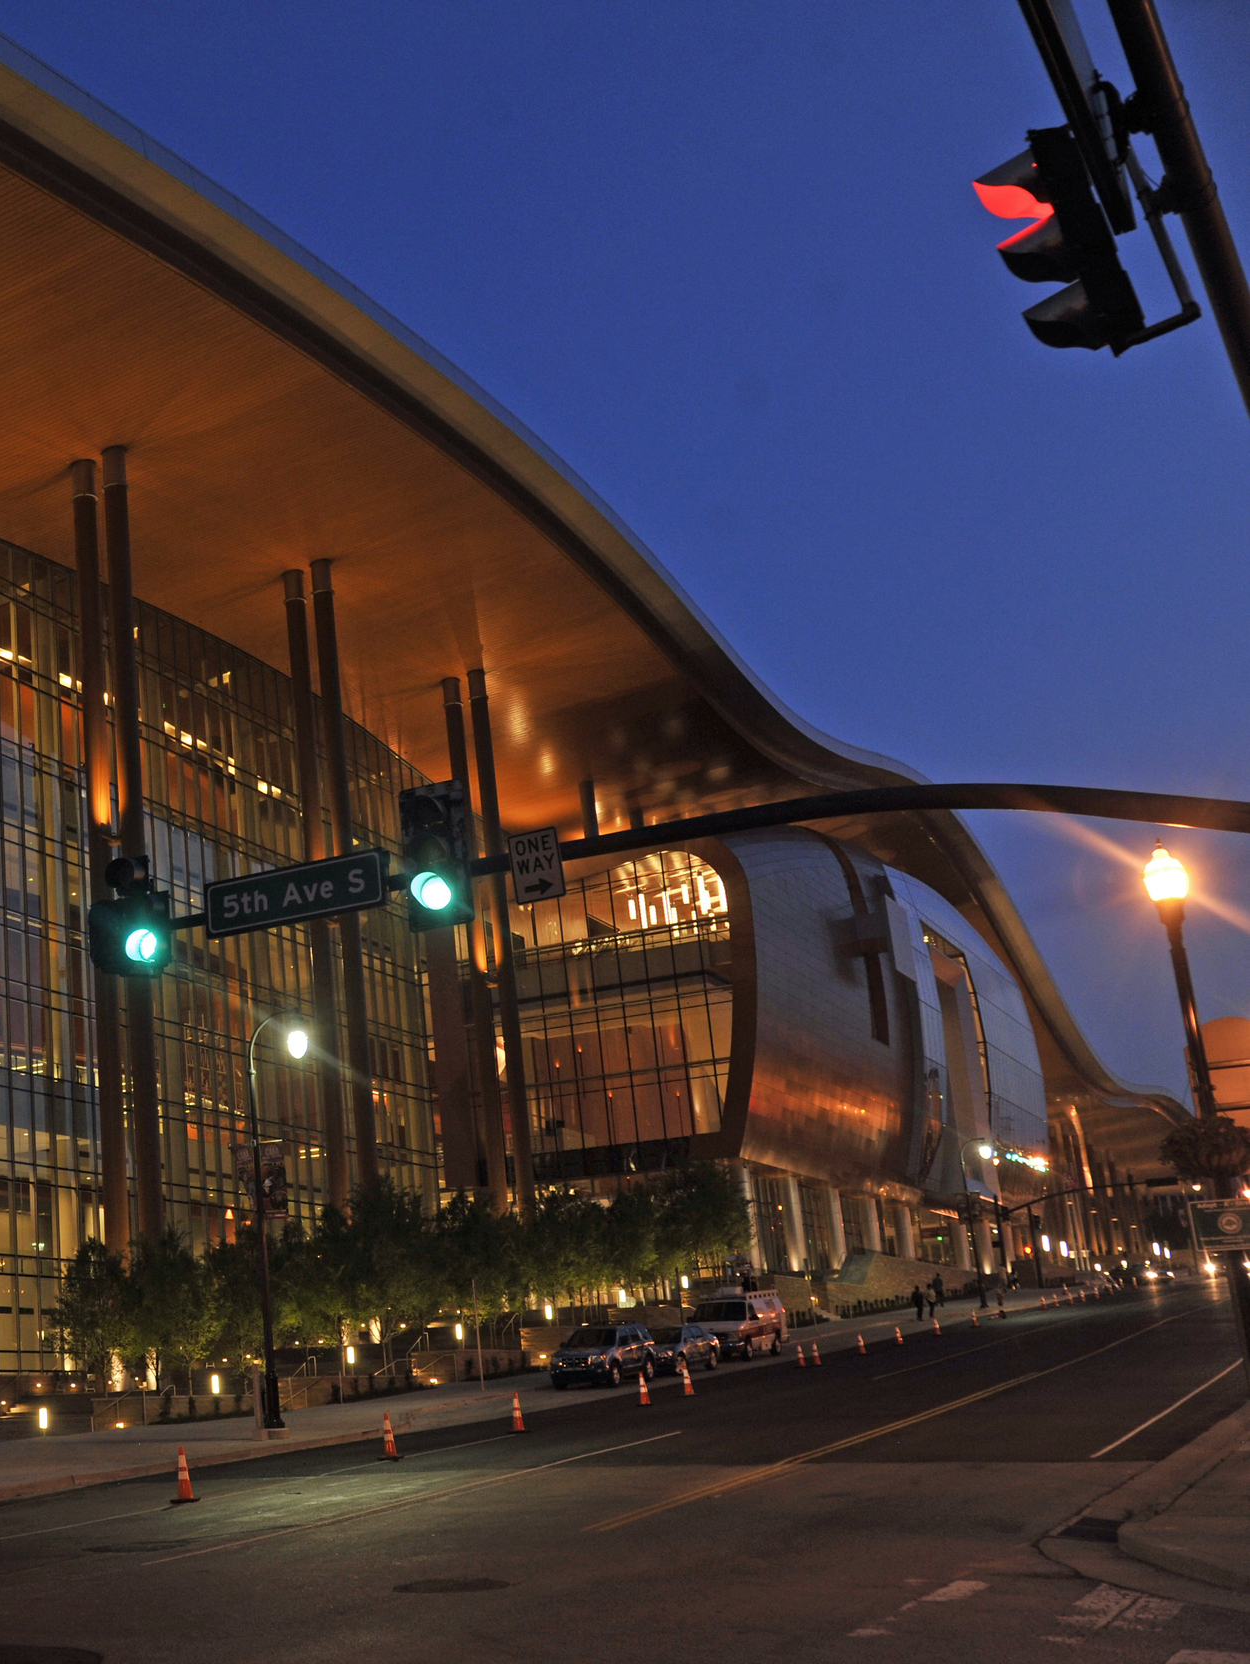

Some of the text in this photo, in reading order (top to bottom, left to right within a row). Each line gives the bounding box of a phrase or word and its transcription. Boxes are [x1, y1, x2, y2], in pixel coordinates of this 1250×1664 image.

[514, 834, 555, 877] ONE WAY
[223, 868, 366, 920] 5th Ave S
